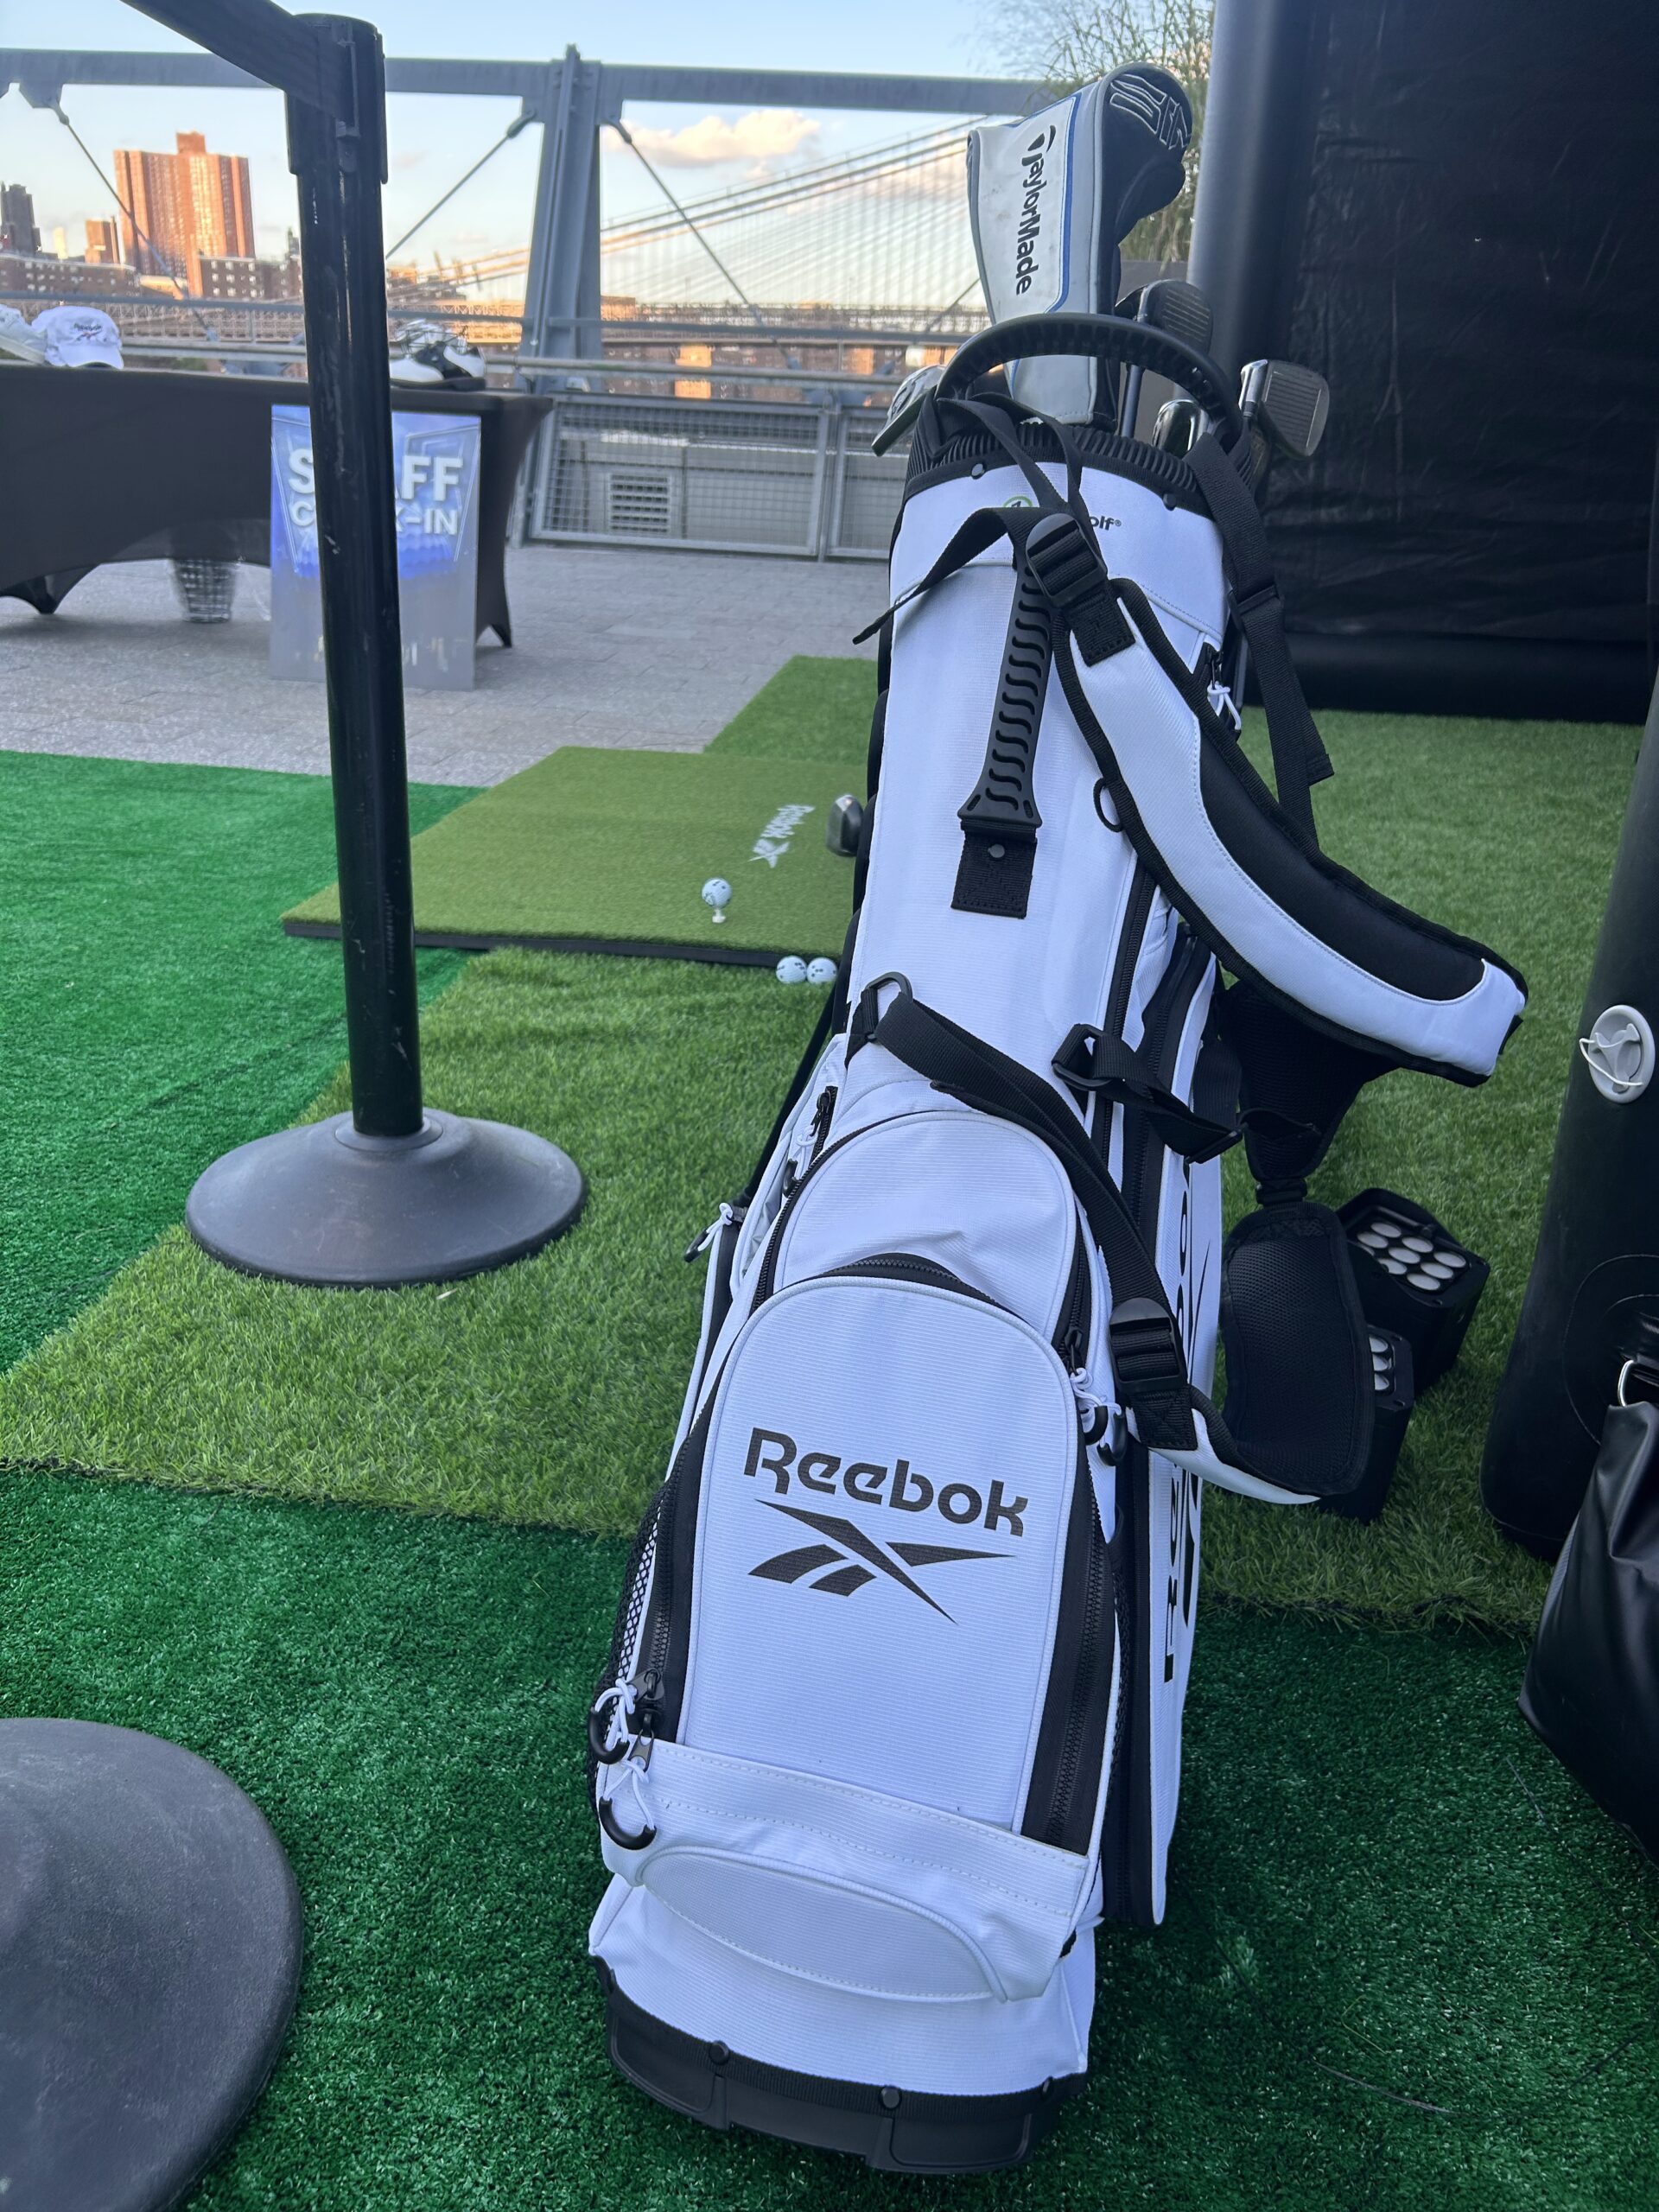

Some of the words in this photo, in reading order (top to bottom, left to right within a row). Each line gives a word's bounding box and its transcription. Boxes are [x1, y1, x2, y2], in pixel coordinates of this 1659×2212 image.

[1014, 124, 1057, 296] TaylorMade
[288, 448, 464, 502] SFF
[289, 500, 459, 536] C-IN
[1090, 515, 1122, 531] olf®
[743, 1427, 1029, 1537] Reebok
